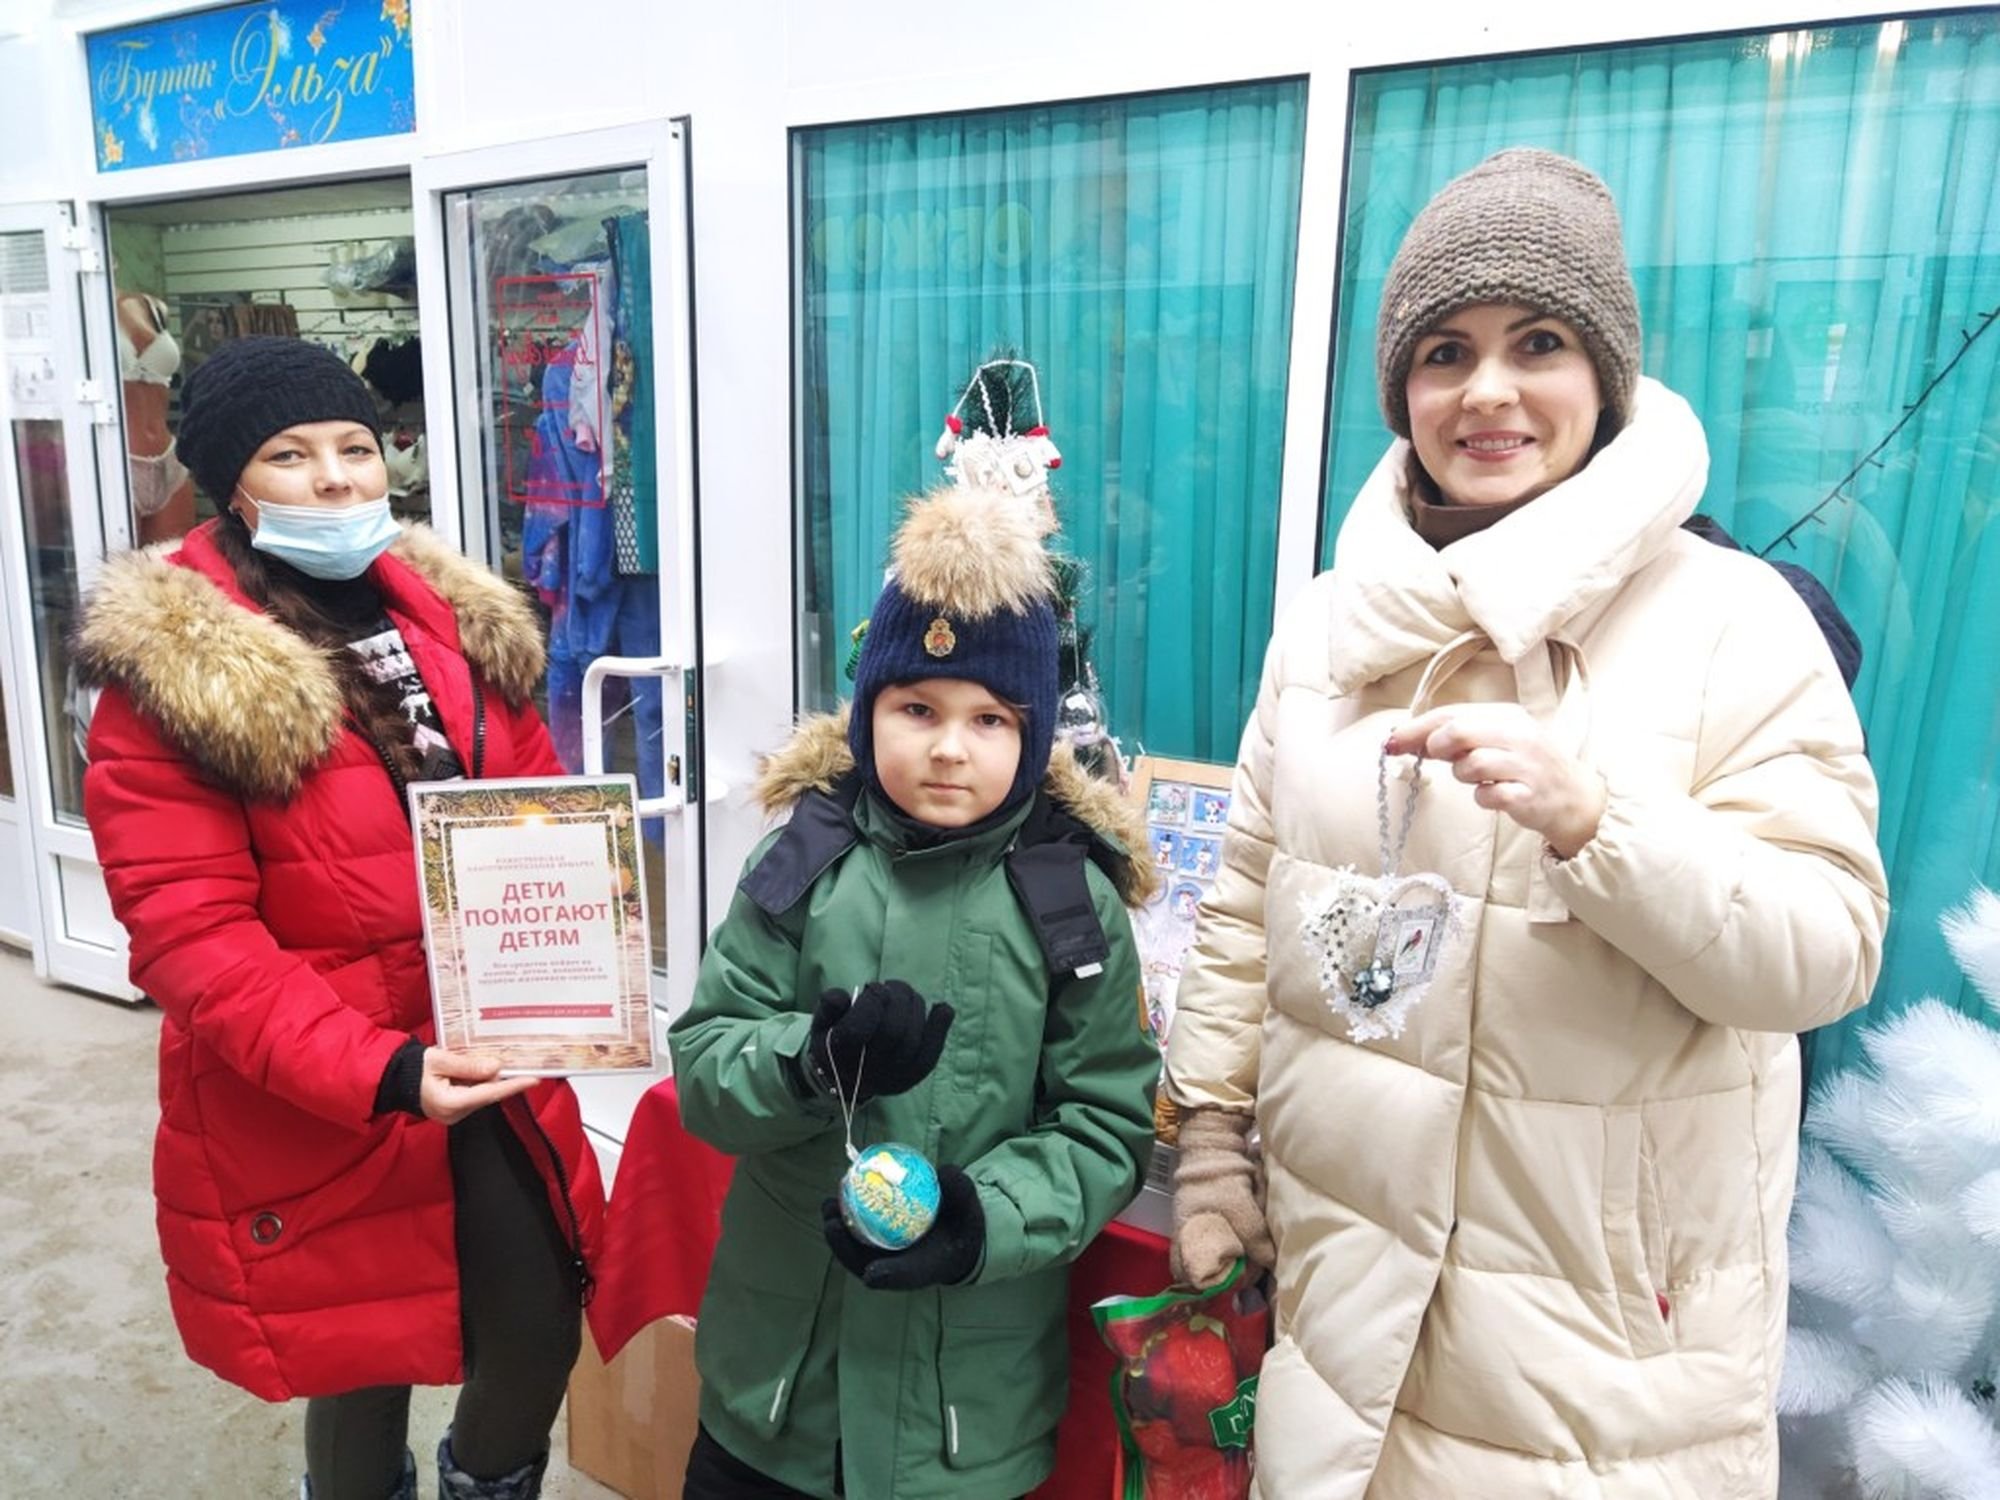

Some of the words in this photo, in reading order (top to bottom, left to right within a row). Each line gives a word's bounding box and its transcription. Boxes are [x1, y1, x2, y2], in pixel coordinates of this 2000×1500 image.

[99, 40, 217, 107] Бутик
[502, 881, 565, 904] ДЕТИ
[464, 904, 608, 926] ПОМОГАЮТ
[499, 929, 580, 952] ДЕТЯМ
